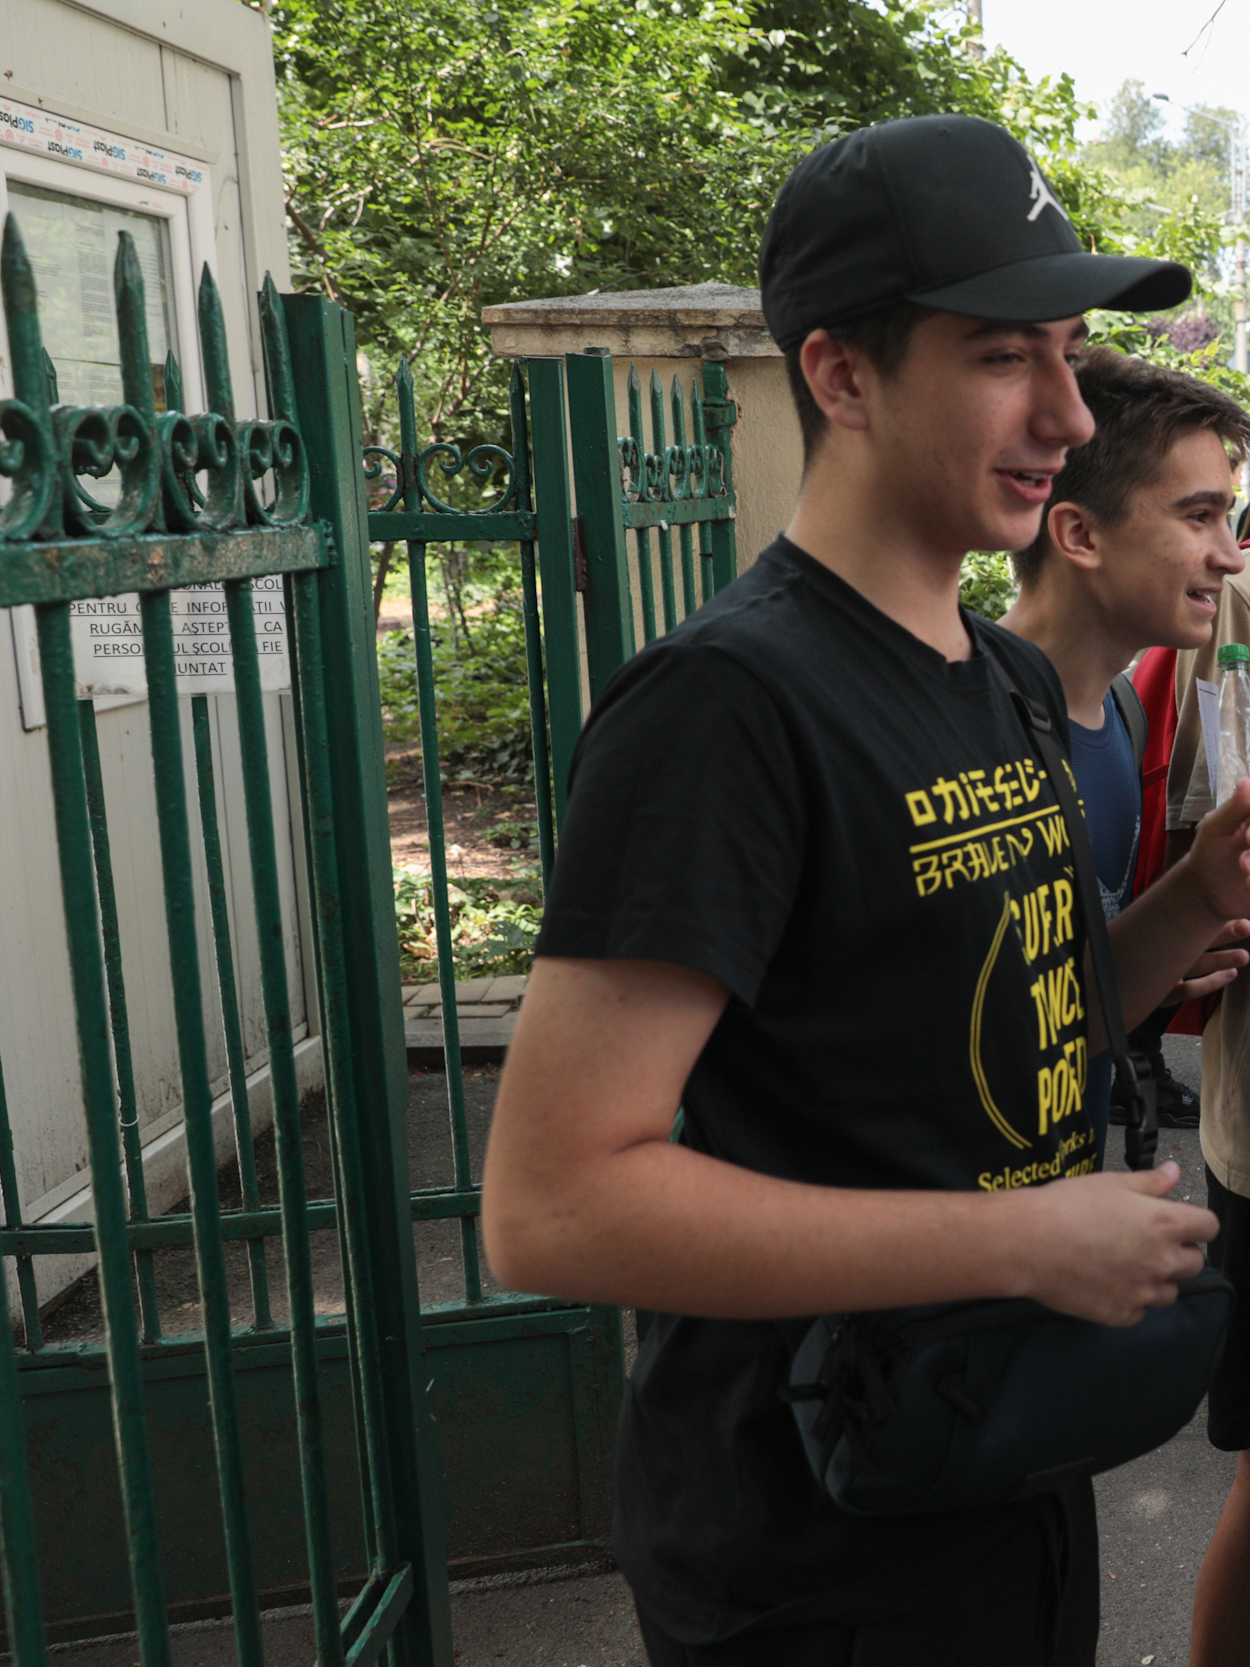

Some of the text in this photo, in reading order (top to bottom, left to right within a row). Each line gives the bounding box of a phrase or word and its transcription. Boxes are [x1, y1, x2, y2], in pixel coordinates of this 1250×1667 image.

[94, 140, 126, 161] SIGPlast
[69, 602, 127, 614] PENTRU
[262, 641, 283, 652] FIE
[977, 1151, 1062, 1192] Selected
